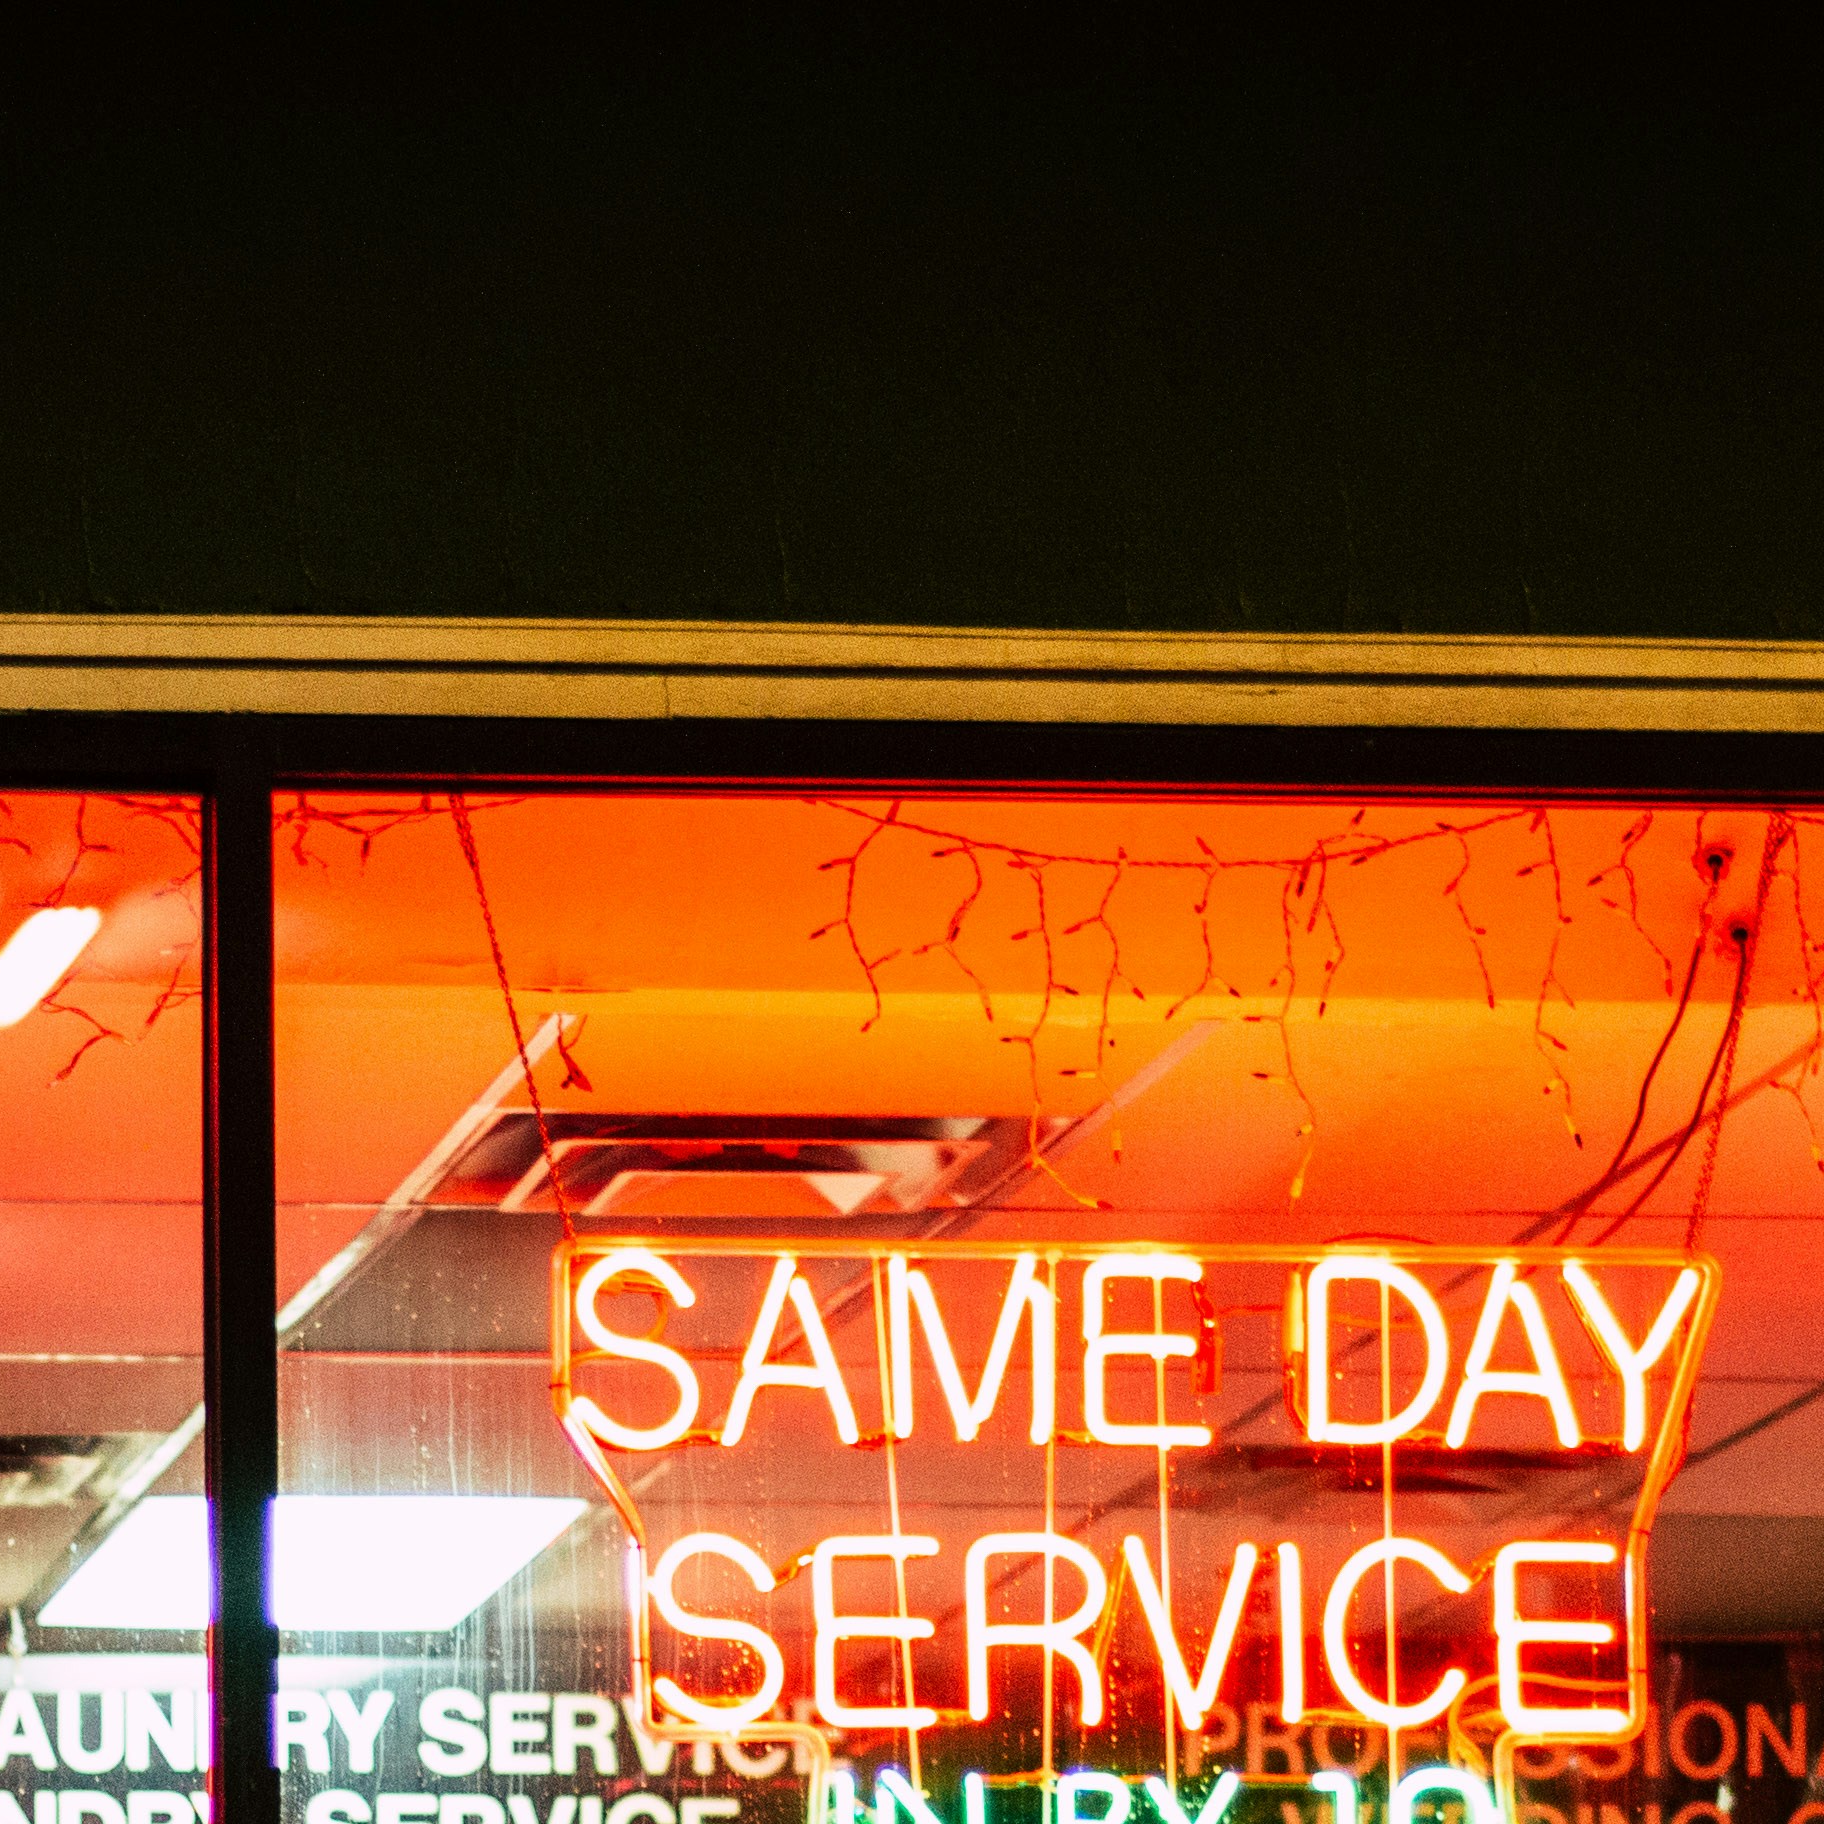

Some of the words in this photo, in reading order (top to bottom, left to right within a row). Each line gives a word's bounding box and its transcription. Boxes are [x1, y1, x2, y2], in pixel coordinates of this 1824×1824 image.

[574, 1252, 1213, 1448] SAME
[1301, 1252, 1702, 1451] DAY
[646, 1530, 1631, 1732] SERVICE
